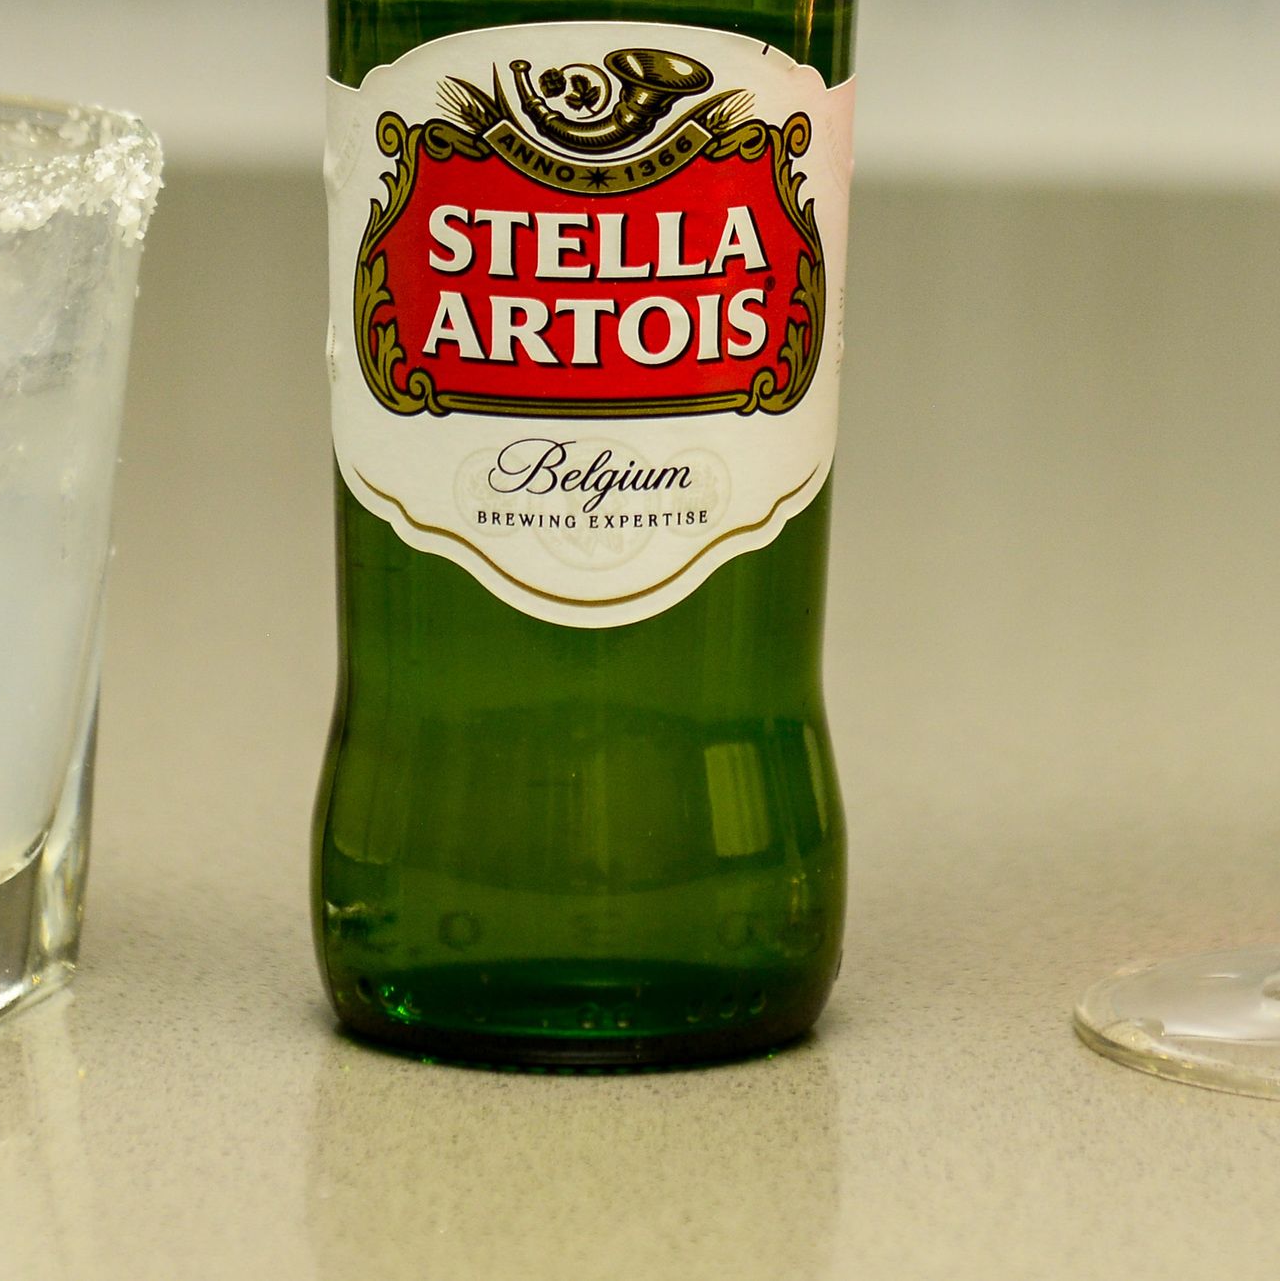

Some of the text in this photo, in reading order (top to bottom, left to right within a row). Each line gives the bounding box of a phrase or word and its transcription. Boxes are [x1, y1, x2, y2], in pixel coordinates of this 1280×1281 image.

[495, 131, 696, 184] ANNO 1366
[427, 204, 769, 280] STELLA
[421, 288, 766, 368] ARTOIS
[487, 437, 693, 514] Belgium
[476, 509, 710, 530] BREWING EXPERTISE
